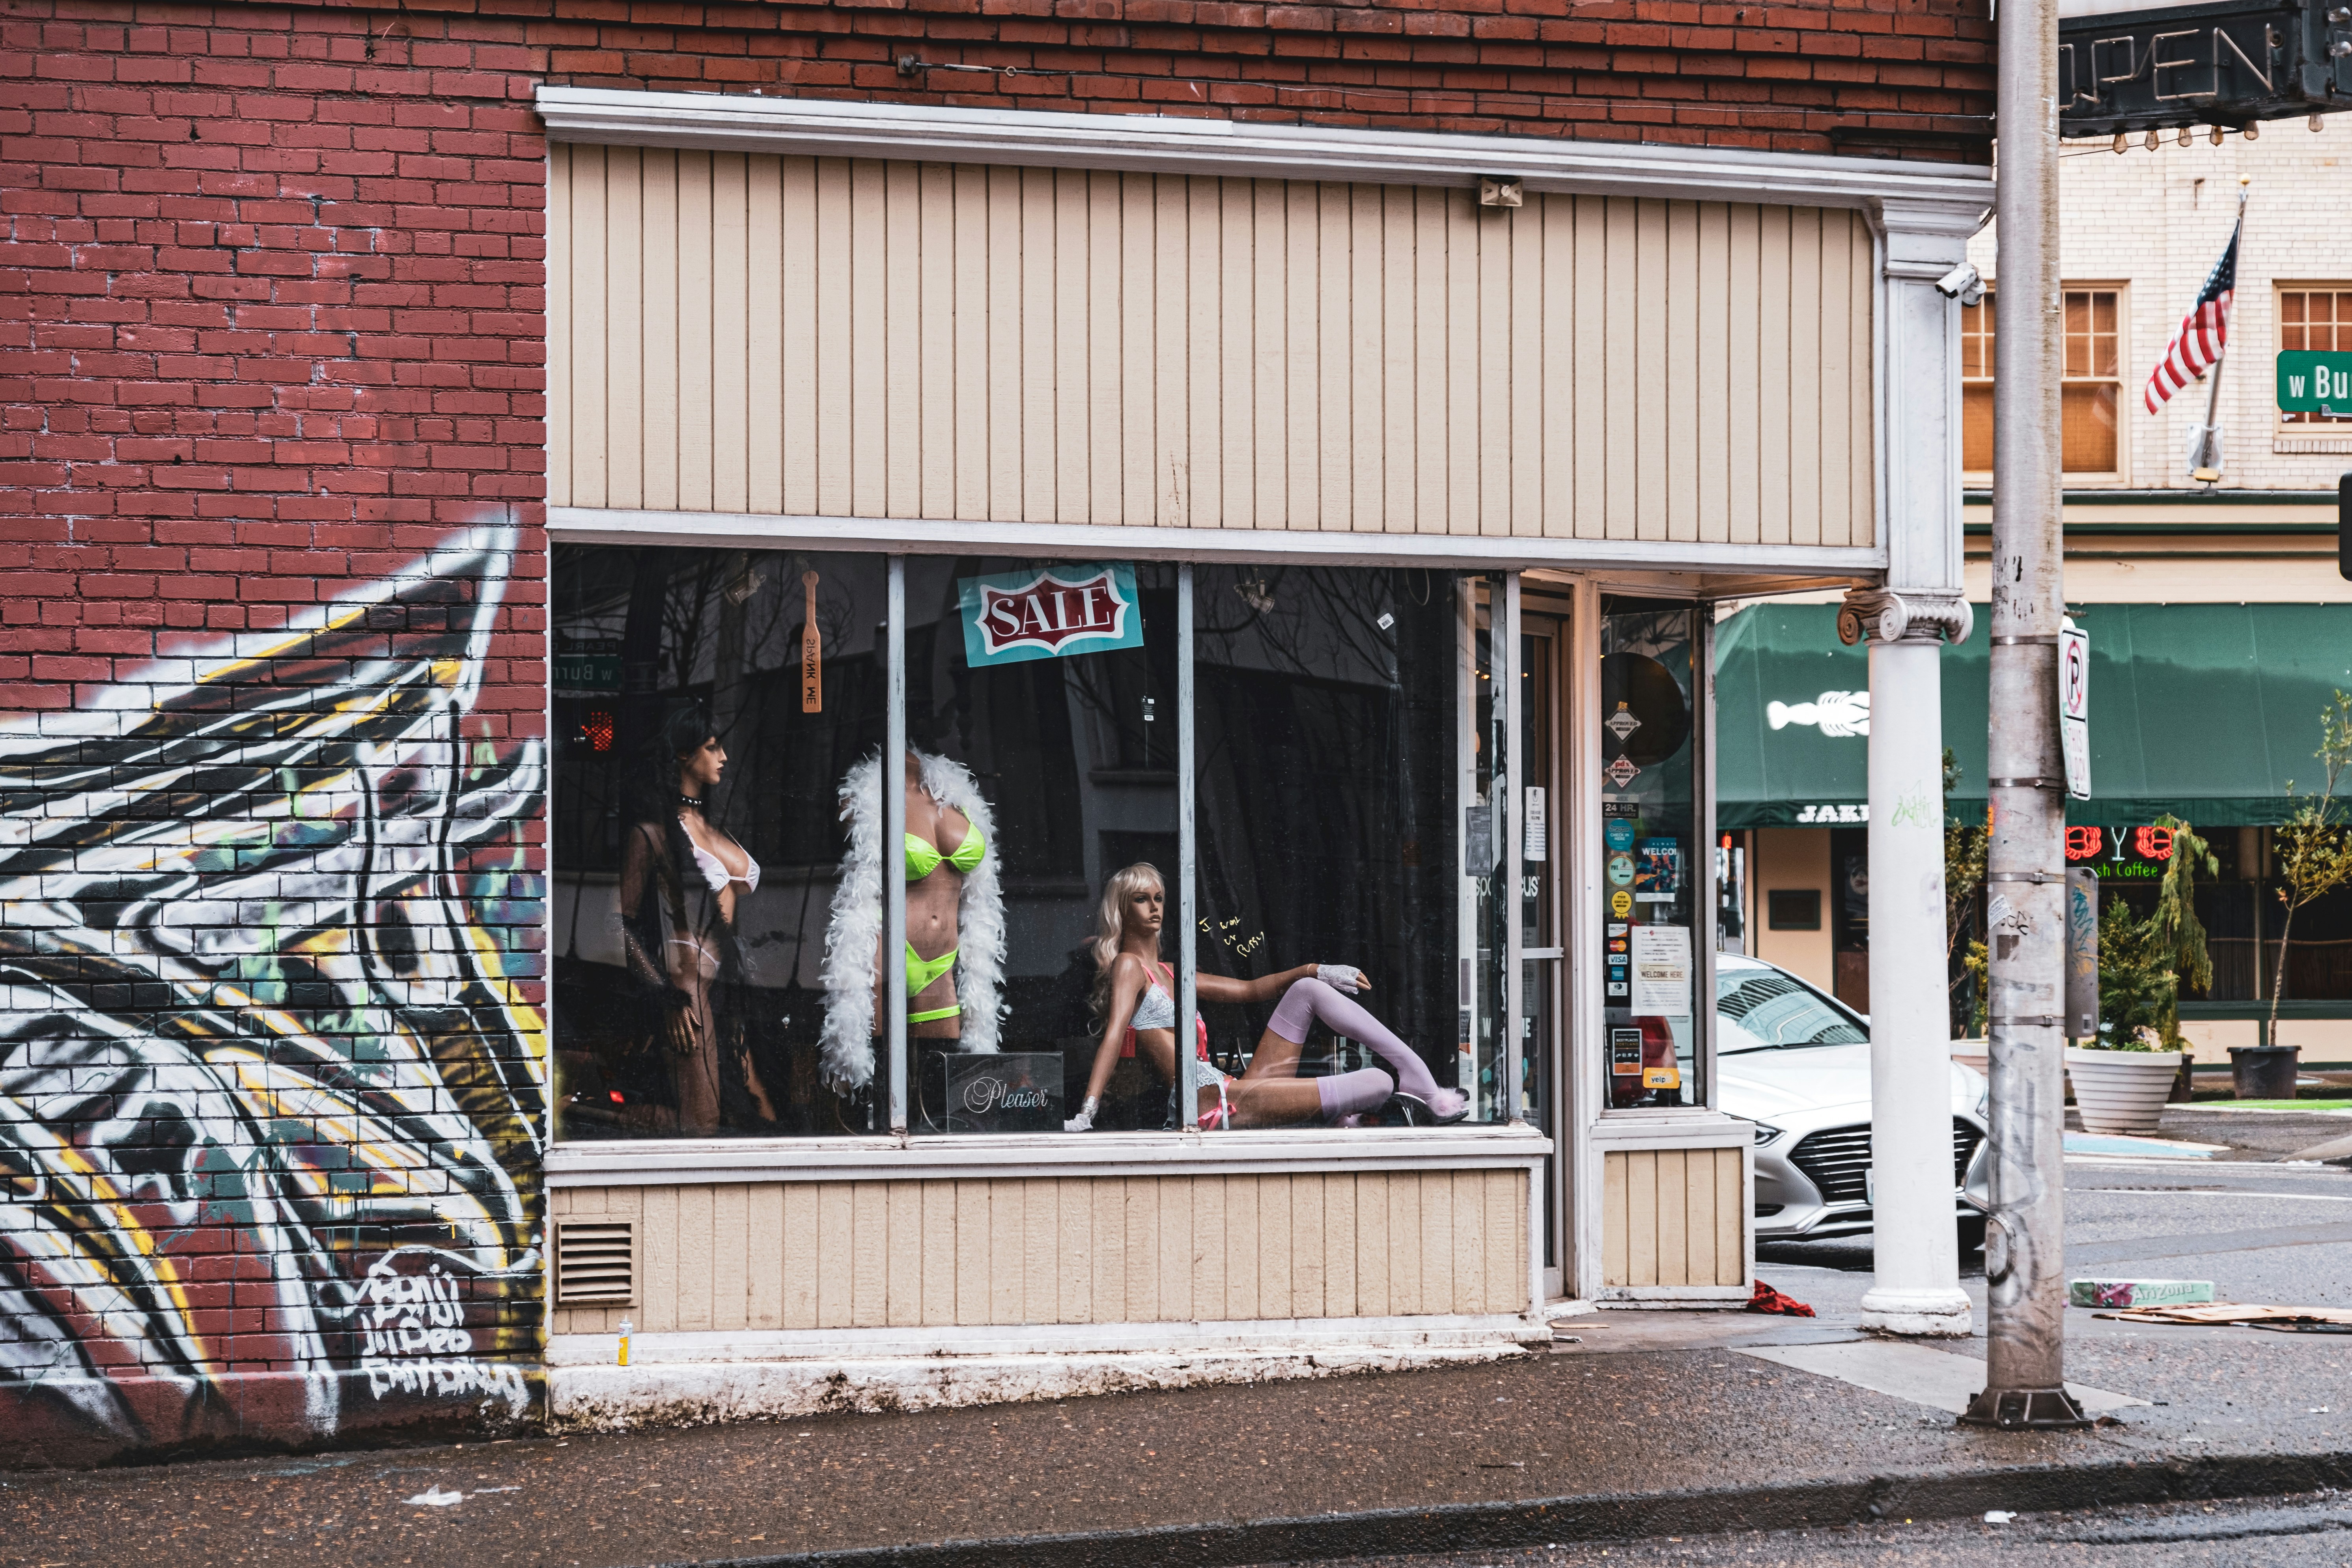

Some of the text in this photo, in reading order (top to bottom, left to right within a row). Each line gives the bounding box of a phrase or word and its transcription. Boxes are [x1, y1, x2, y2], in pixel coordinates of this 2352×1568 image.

[2314, 365, 2352, 399] Bu
[991, 586, 1111, 637] SALE
[1605, 803, 1636, 812] 24 HR.
[2116, 861, 2158, 877] Coffee
